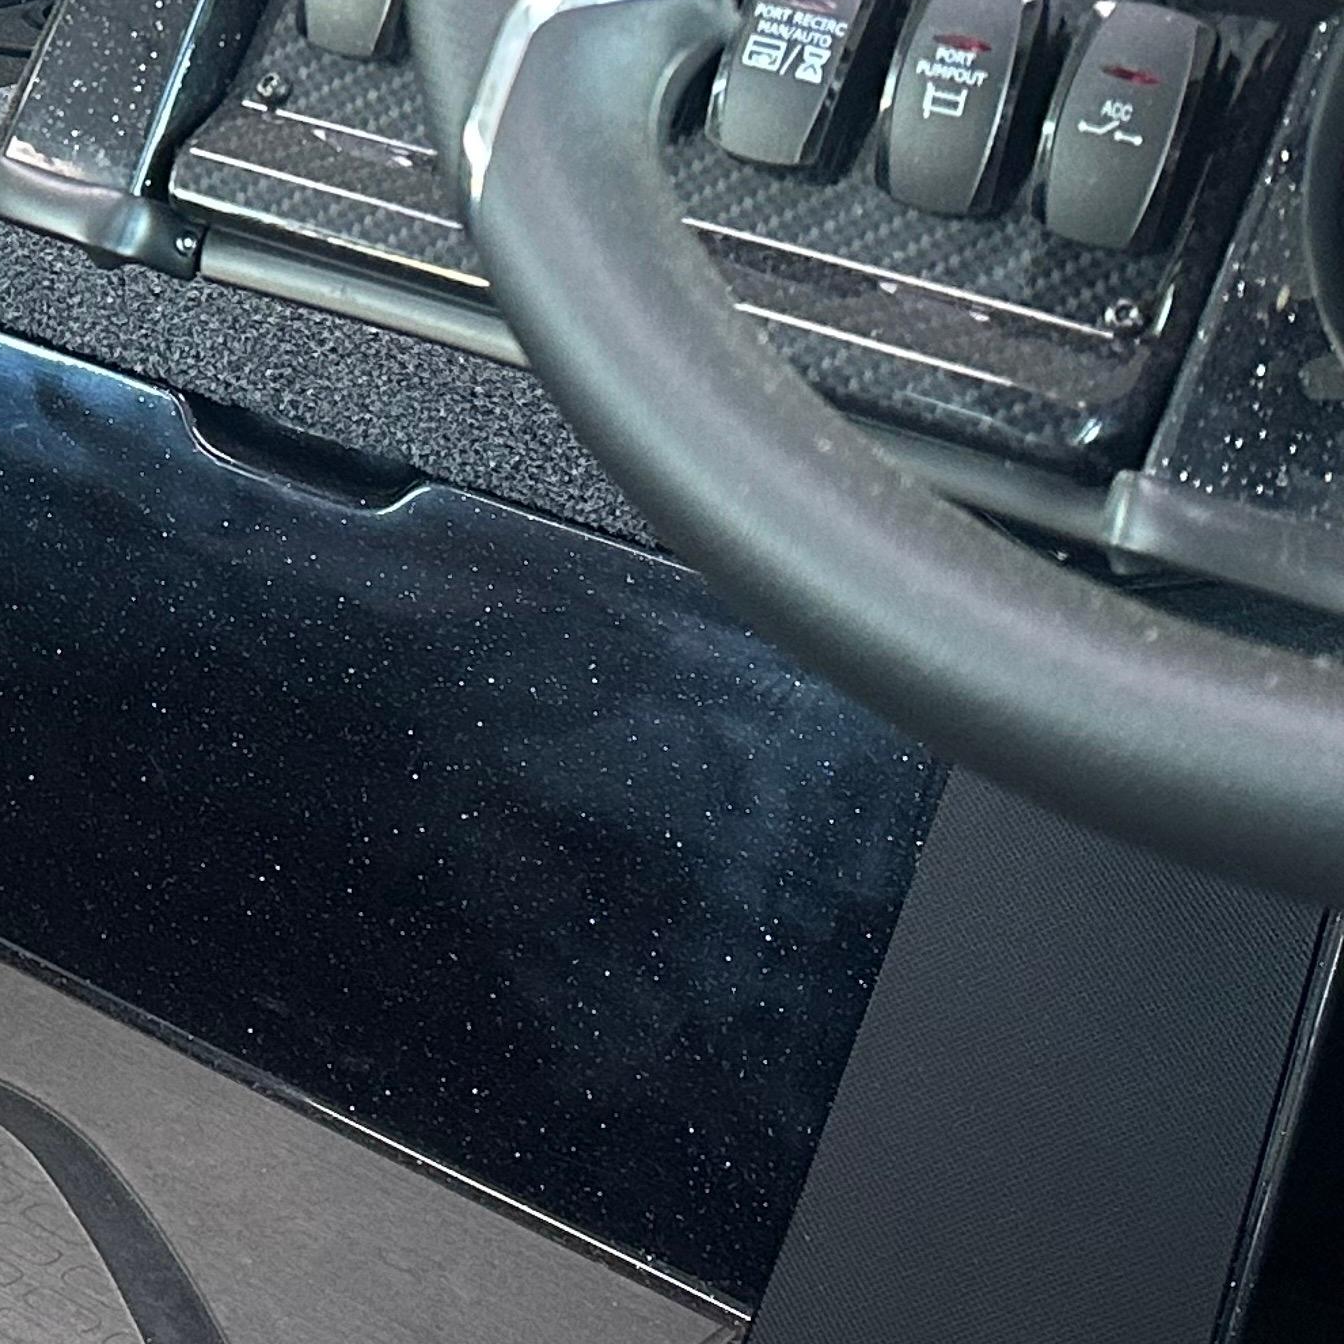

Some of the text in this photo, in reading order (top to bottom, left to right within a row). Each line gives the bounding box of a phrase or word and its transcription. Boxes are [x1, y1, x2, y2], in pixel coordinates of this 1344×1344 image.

[753, 1, 848, 38] PORT RECIRC
[756, 19, 832, 49] MAN/AUTO
[935, 45, 977, 67] PORT
[915, 58, 989, 89] PUMPOUT
[1100, 98, 1134, 123] ACC
